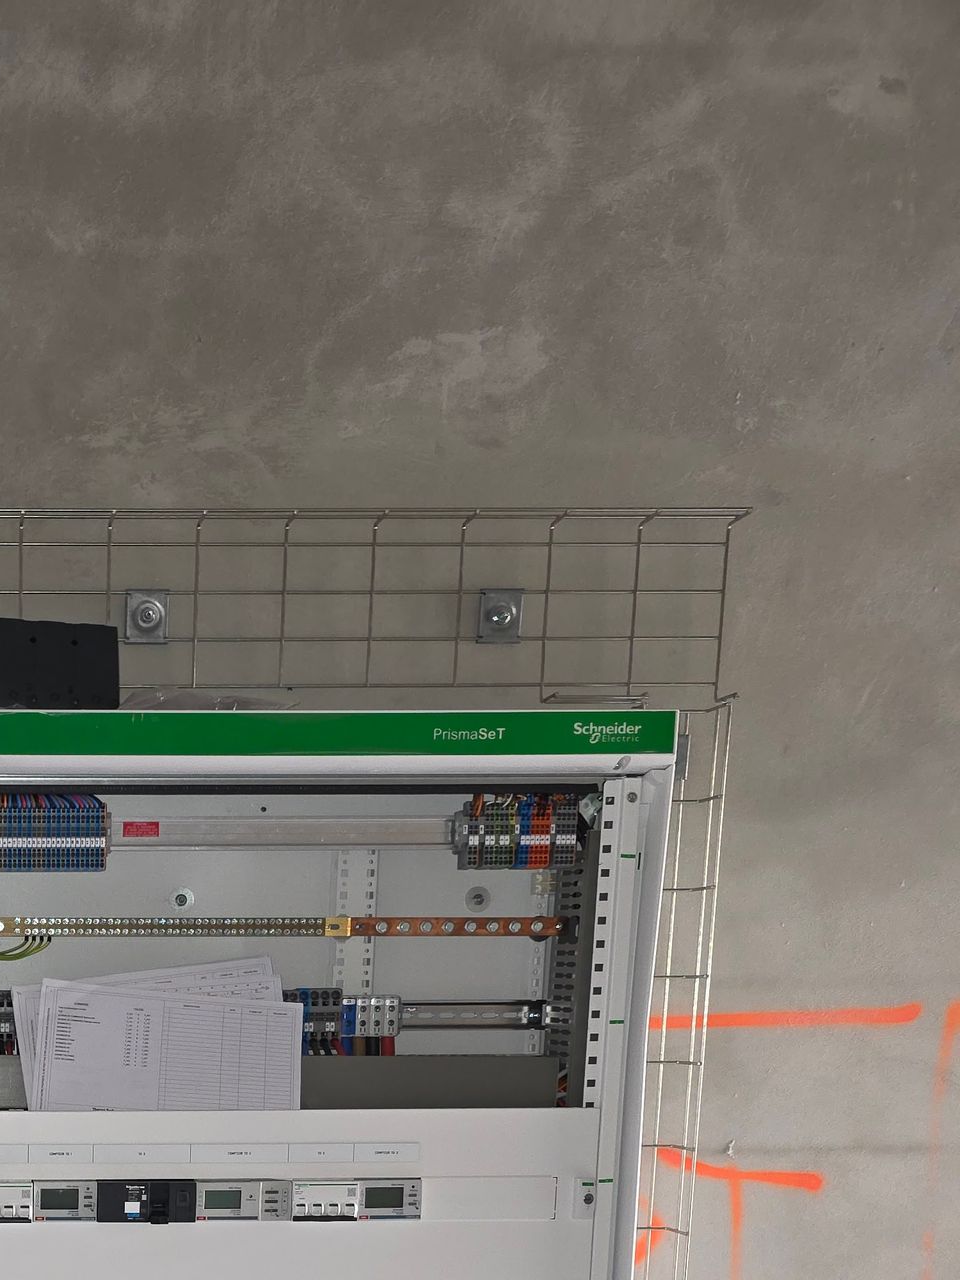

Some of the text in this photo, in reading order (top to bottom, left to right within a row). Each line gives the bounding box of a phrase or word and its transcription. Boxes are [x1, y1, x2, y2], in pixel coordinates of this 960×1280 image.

[433, 727, 506, 740] PrismaSeT
[573, 722, 642, 735] Schneider
[602, 735, 640, 743] Electric
